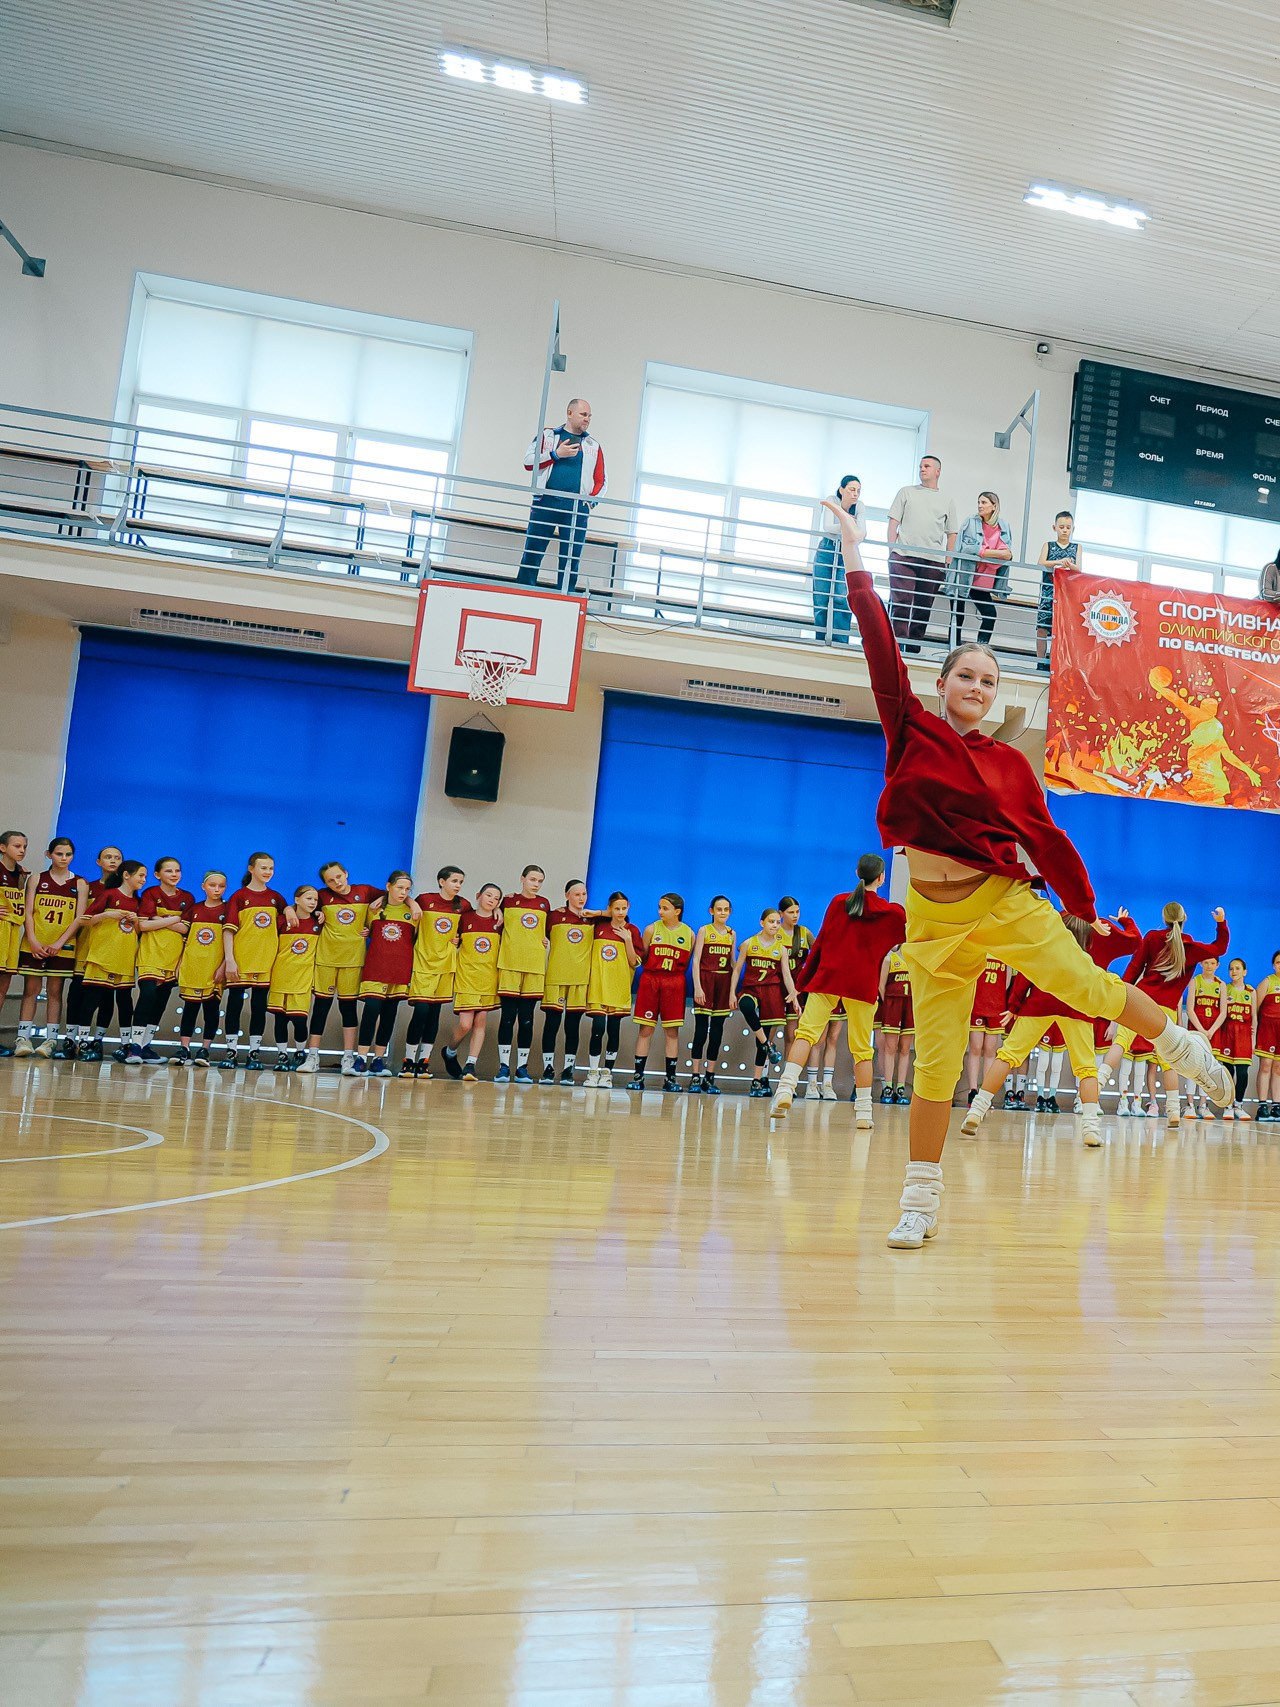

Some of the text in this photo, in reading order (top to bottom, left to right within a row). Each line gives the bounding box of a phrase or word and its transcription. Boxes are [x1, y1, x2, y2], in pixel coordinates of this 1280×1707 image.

[1149, 395, 1171, 406] СЧЕТ
[1195, 404, 1229, 418] ПЕРИОД
[1138, 452, 1164, 463] ФОЛЫ
[1195, 448, 1224, 460] ВРЕМЯ
[1252, 472, 1277, 483] ФОЛЫ
[1158, 637, 1182, 649] ПО
[38, 897, 74, 910] СШОР 5
[44, 910, 64, 925] 41
[708, 945, 731, 955] СШОР
[757, 969, 768, 982] 7
[984, 971, 998, 984] 79
[1244, 1006, 1250, 1014] 5
